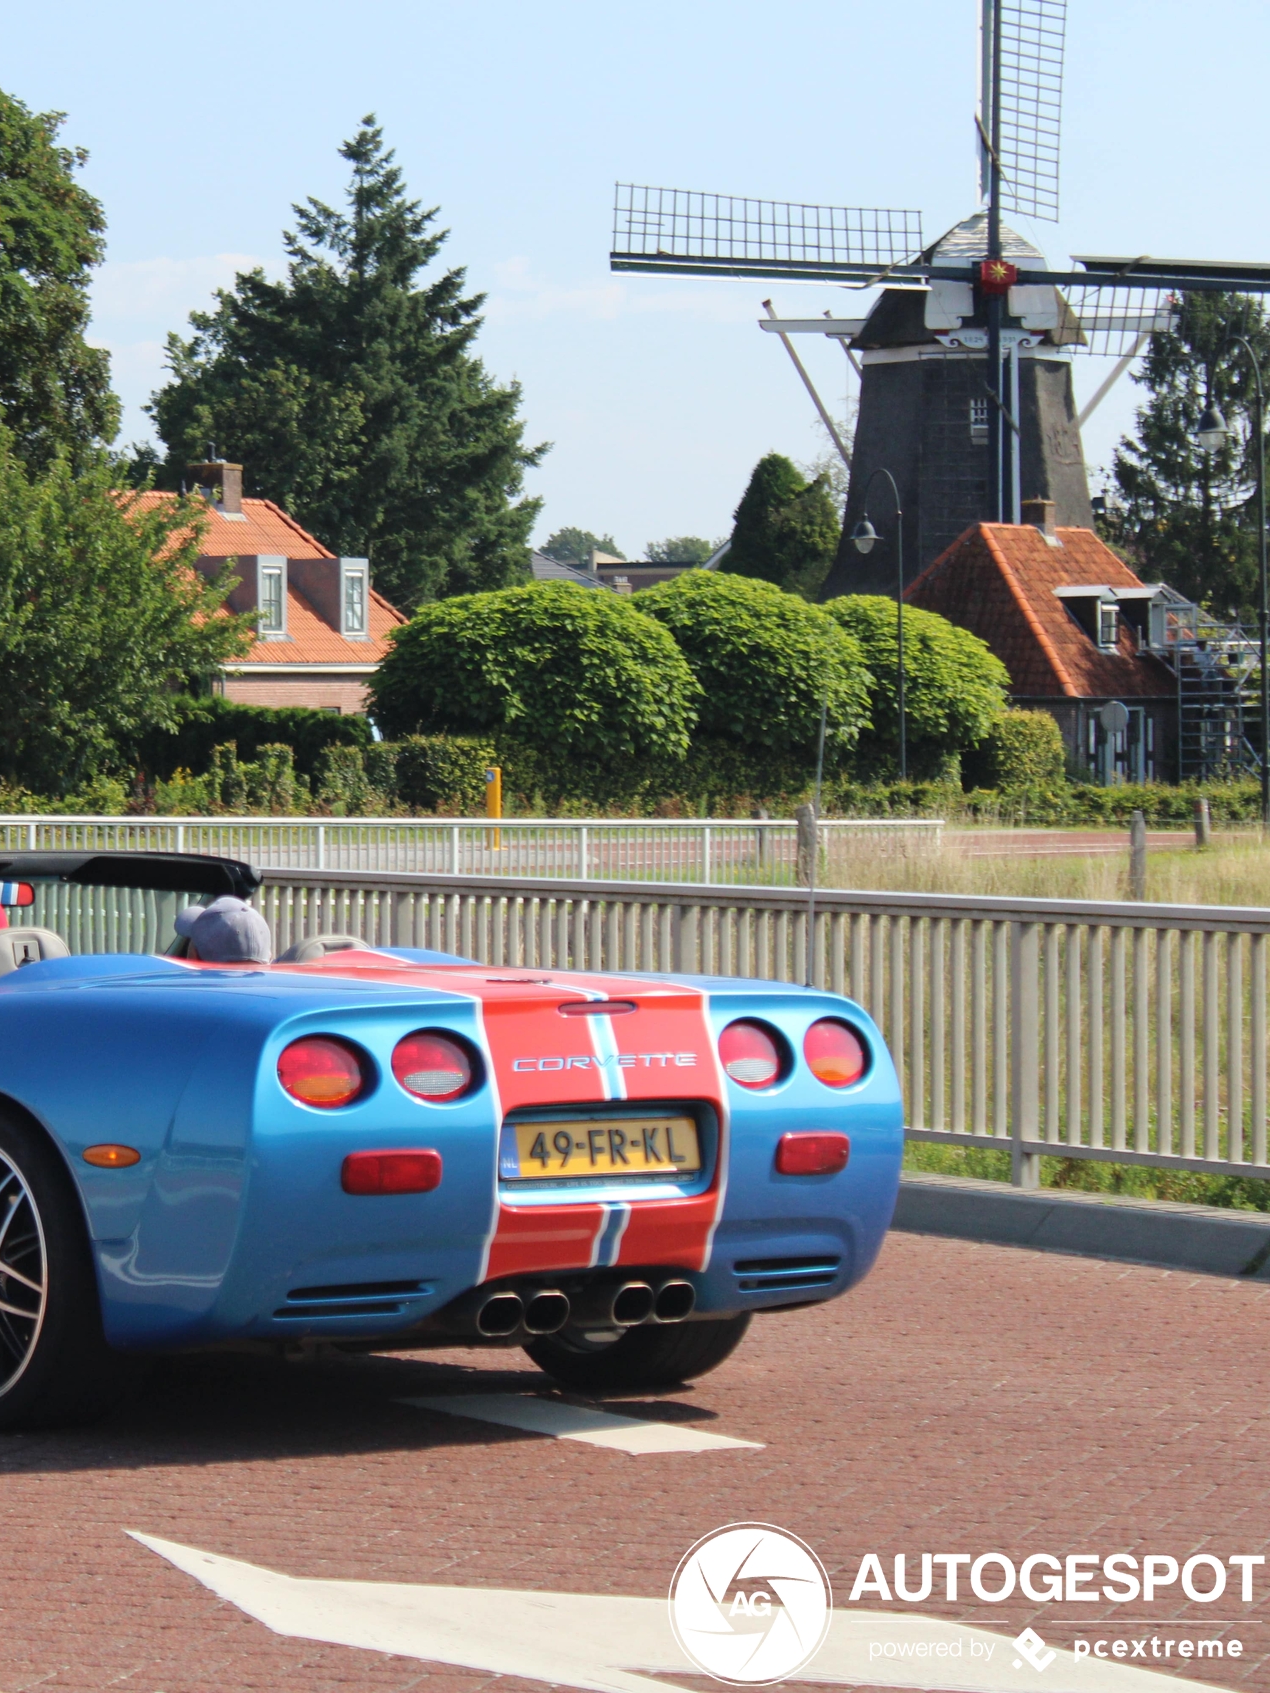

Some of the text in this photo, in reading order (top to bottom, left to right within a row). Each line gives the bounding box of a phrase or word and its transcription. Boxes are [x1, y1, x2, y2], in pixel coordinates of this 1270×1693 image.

[513, 1053, 698, 1072] CORVETTE
[503, 1126, 687, 1169] NL 49-FR-KL
